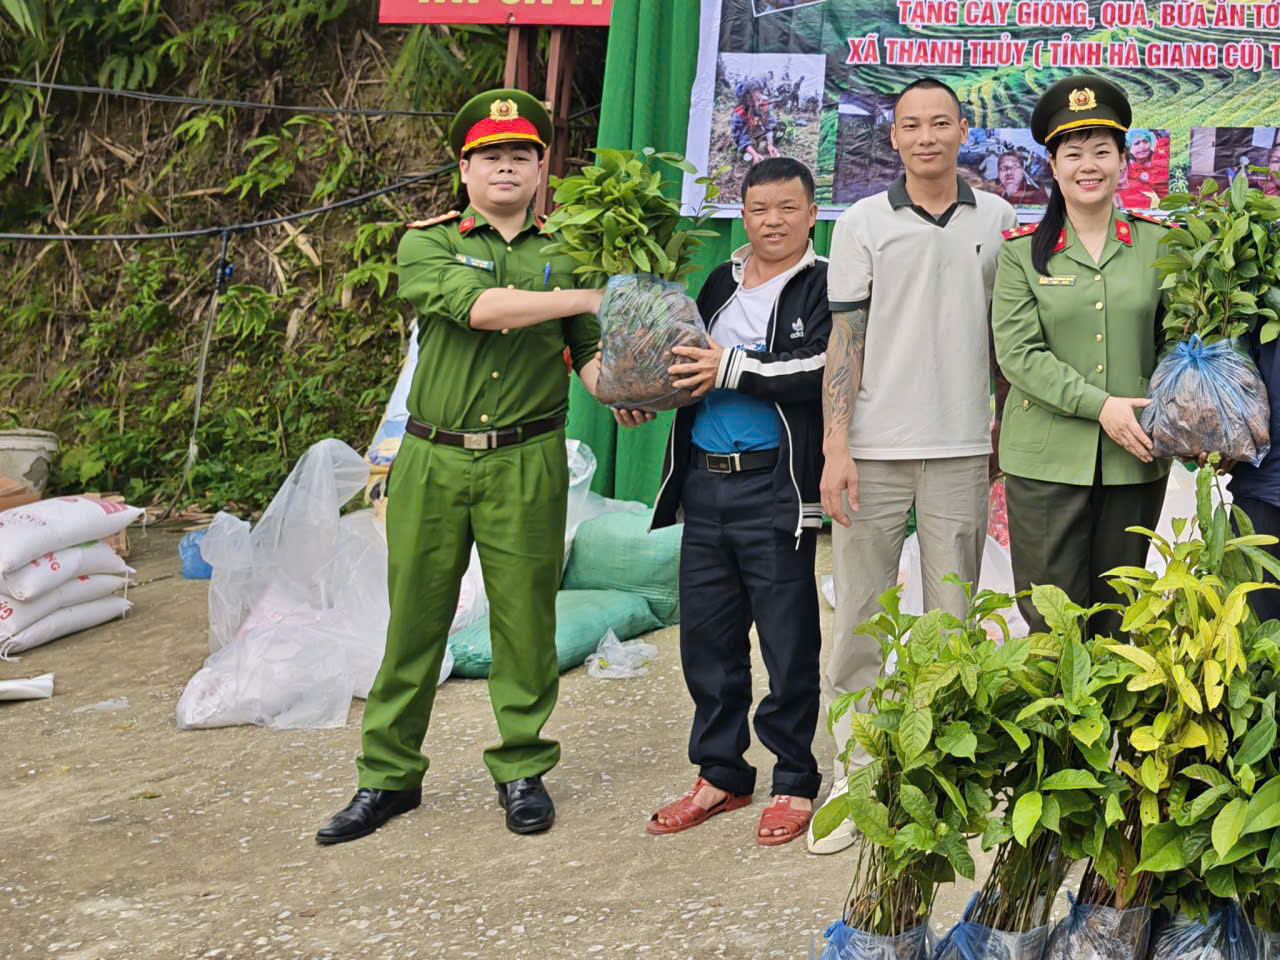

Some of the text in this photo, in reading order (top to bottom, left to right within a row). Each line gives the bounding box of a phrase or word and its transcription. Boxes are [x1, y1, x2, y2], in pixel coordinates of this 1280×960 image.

[846, 32, 880, 66] XÃ
[884, 37, 964, 67] THANH
[968, 32, 1028, 68] THỦY
[1048, 33, 1103, 68] TỈNH
[1107, 36, 1141, 69] HÀ
[1145, 41, 1218, 70] GIANG
[1222, 38, 1264, 72] CŨ)
